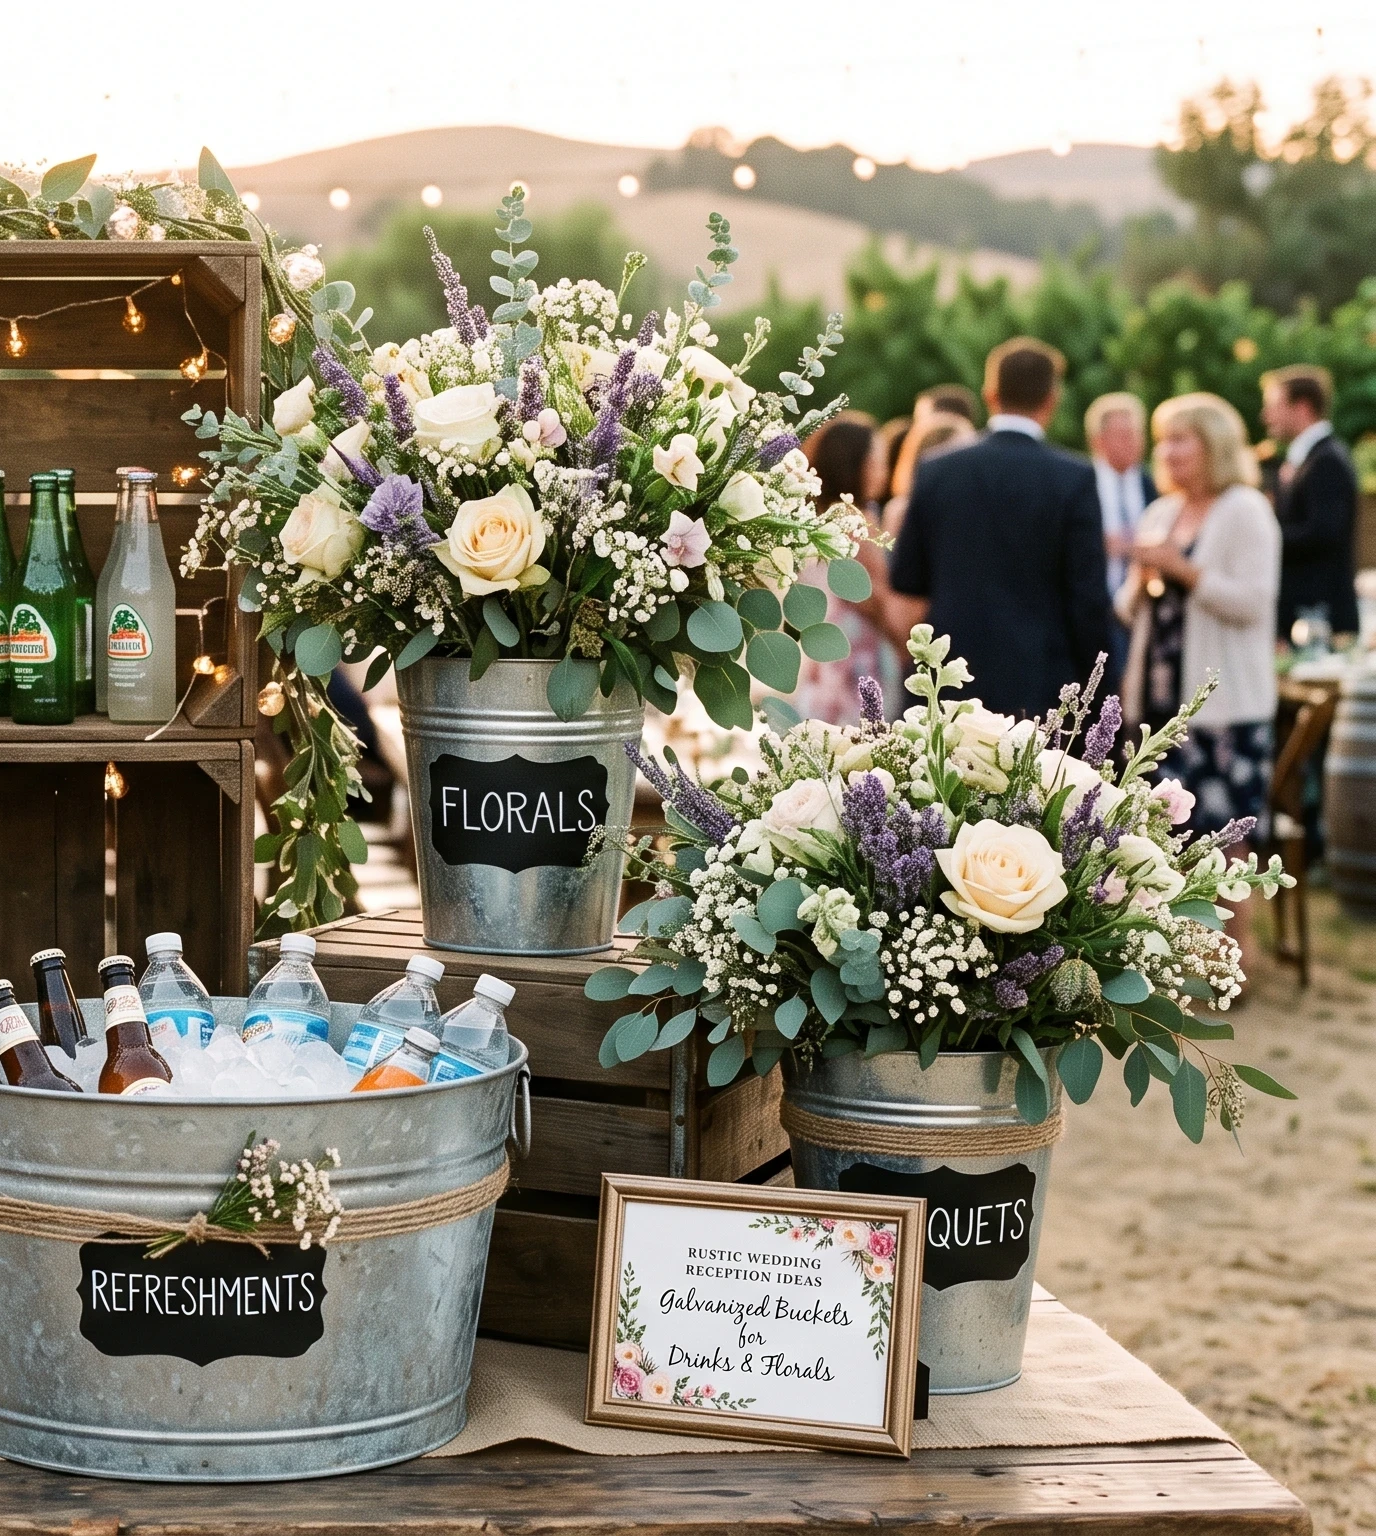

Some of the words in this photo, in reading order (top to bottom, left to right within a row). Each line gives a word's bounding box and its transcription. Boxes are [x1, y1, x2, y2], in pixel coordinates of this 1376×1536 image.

[442, 786, 596, 834] FLORALS
[927, 1198, 1027, 1250] QUETS
[685, 1264, 771, 1283] RECEPTION
[776, 1272, 822, 1288] IDEAS
[688, 1247, 742, 1263] RUSTIC
[747, 1252, 822, 1270] WEDDING
[91, 1269, 315, 1316] REFRESHMENTS
[659, 1287, 771, 1325] Galvanized
[774, 1296, 853, 1326] Buckets
[738, 1321, 767, 1349] for
[668, 1344, 735, 1372] Drinks
[740, 1353, 753, 1373] &
[760, 1352, 835, 1382] Florals
